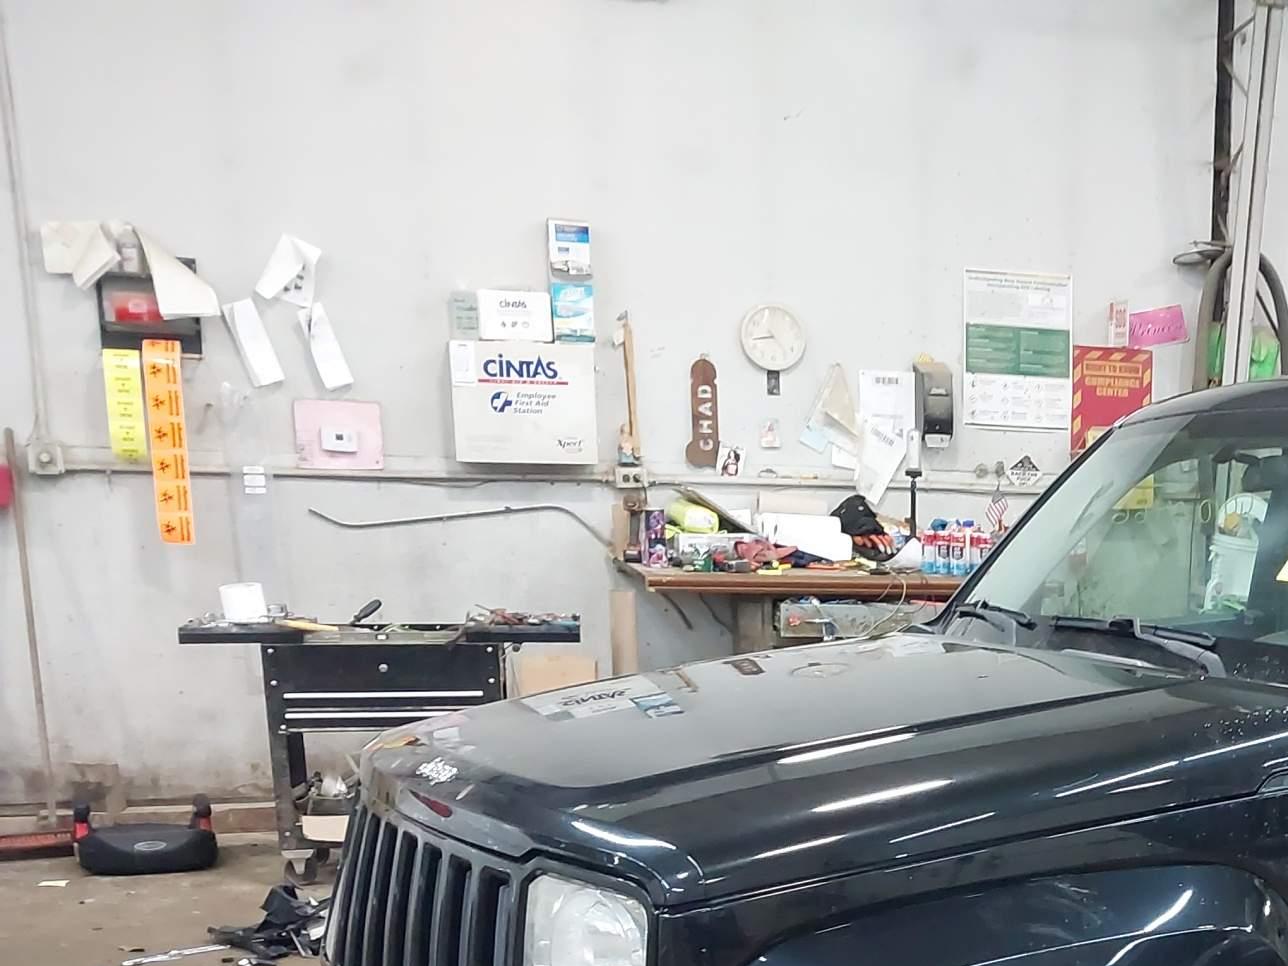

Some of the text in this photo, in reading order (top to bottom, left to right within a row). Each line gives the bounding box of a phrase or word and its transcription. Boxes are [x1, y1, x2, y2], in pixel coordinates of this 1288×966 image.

[516, 392, 557, 401] Employee
[535, 399, 549, 407] Aid
[513, 407, 543, 415] Station
[697, 384, 714, 451] CHAD
